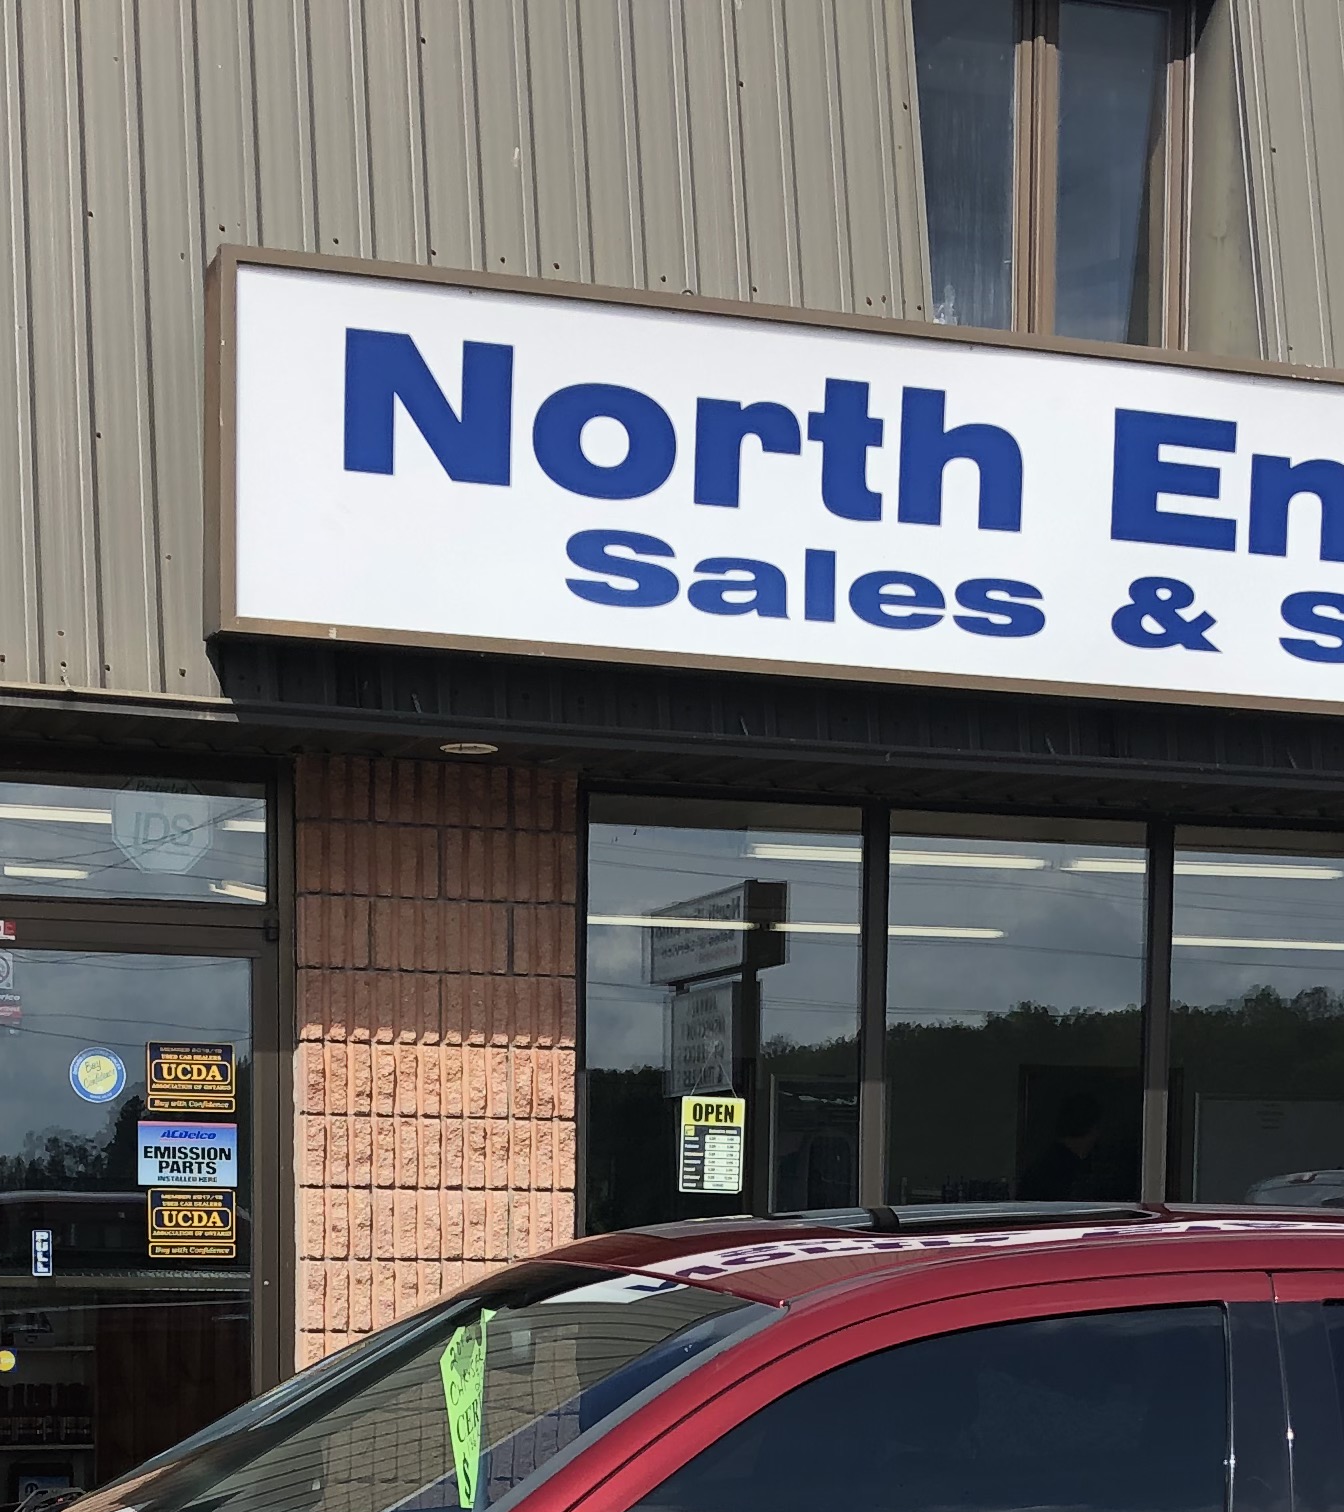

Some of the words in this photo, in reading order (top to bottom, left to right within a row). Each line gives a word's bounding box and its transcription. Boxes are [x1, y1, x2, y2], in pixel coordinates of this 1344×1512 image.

[343, 327, 1024, 534] North
[564, 529, 1047, 638] Sales
[1110, 576, 1223, 653] &
[160, 1063, 224, 1081] UCDA
[692, 1102, 735, 1124] OPEN
[160, 1129, 217, 1140] ACDelco
[143, 1145, 232, 1161] EMISSION
[158, 1160, 217, 1175] PARTS
[161, 1210, 224, 1227] UCDA
[35, 1231, 49, 1273] PULL
